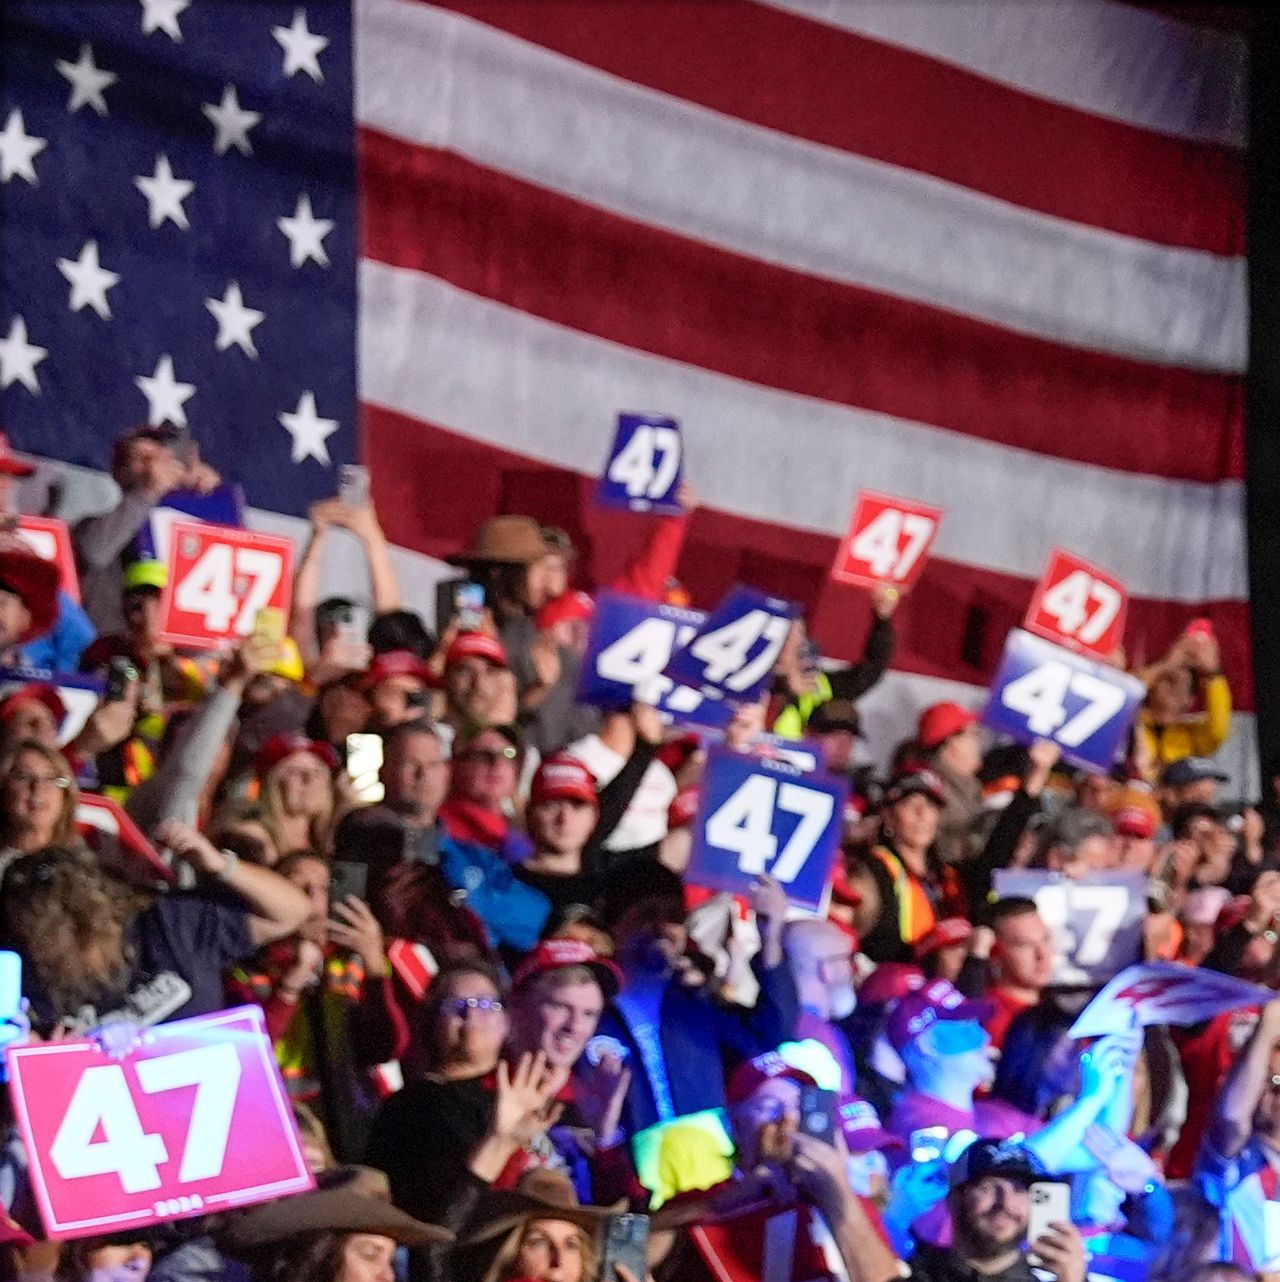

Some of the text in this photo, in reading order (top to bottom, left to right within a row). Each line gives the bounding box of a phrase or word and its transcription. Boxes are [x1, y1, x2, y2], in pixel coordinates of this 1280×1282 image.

[609, 424, 681, 498] 47
[851, 506, 935, 579] 47
[176, 544, 284, 636] 47
[1041, 570, 1122, 643] 47
[692, 609, 793, 692] 47
[1002, 660, 1127, 747] 47
[706, 773, 834, 884] 47
[50, 1042, 242, 1193] 47
